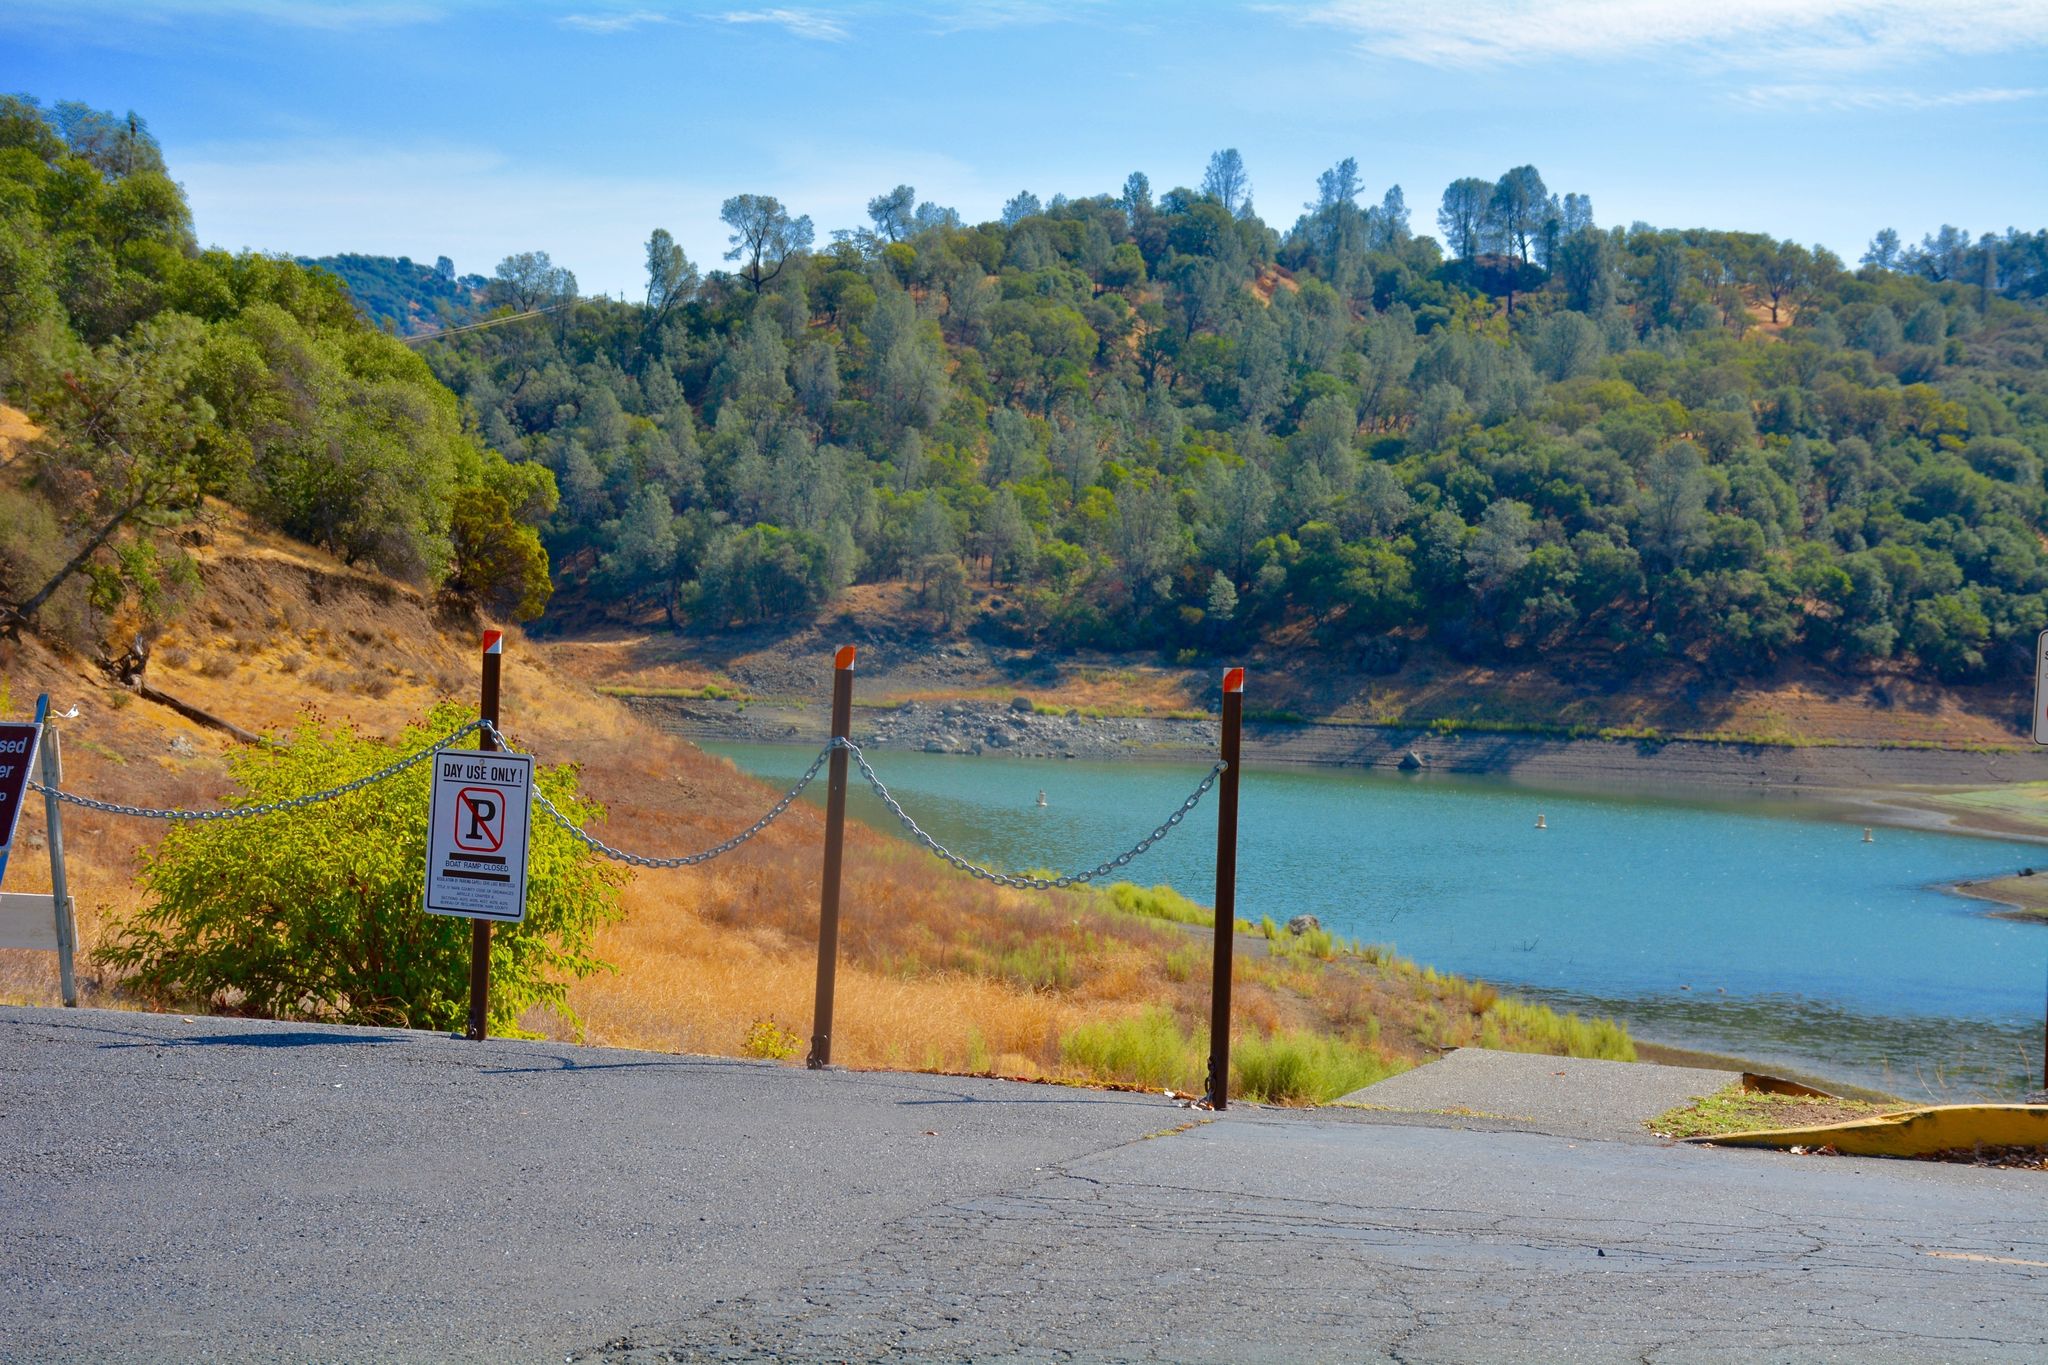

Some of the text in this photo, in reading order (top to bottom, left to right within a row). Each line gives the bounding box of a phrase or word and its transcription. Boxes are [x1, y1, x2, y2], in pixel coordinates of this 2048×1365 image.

[443, 763, 463, 778] DAY
[466, 765, 487, 780] USE
[445, 860, 462, 868] BOAT
[483, 863, 509, 872] CLOSED
